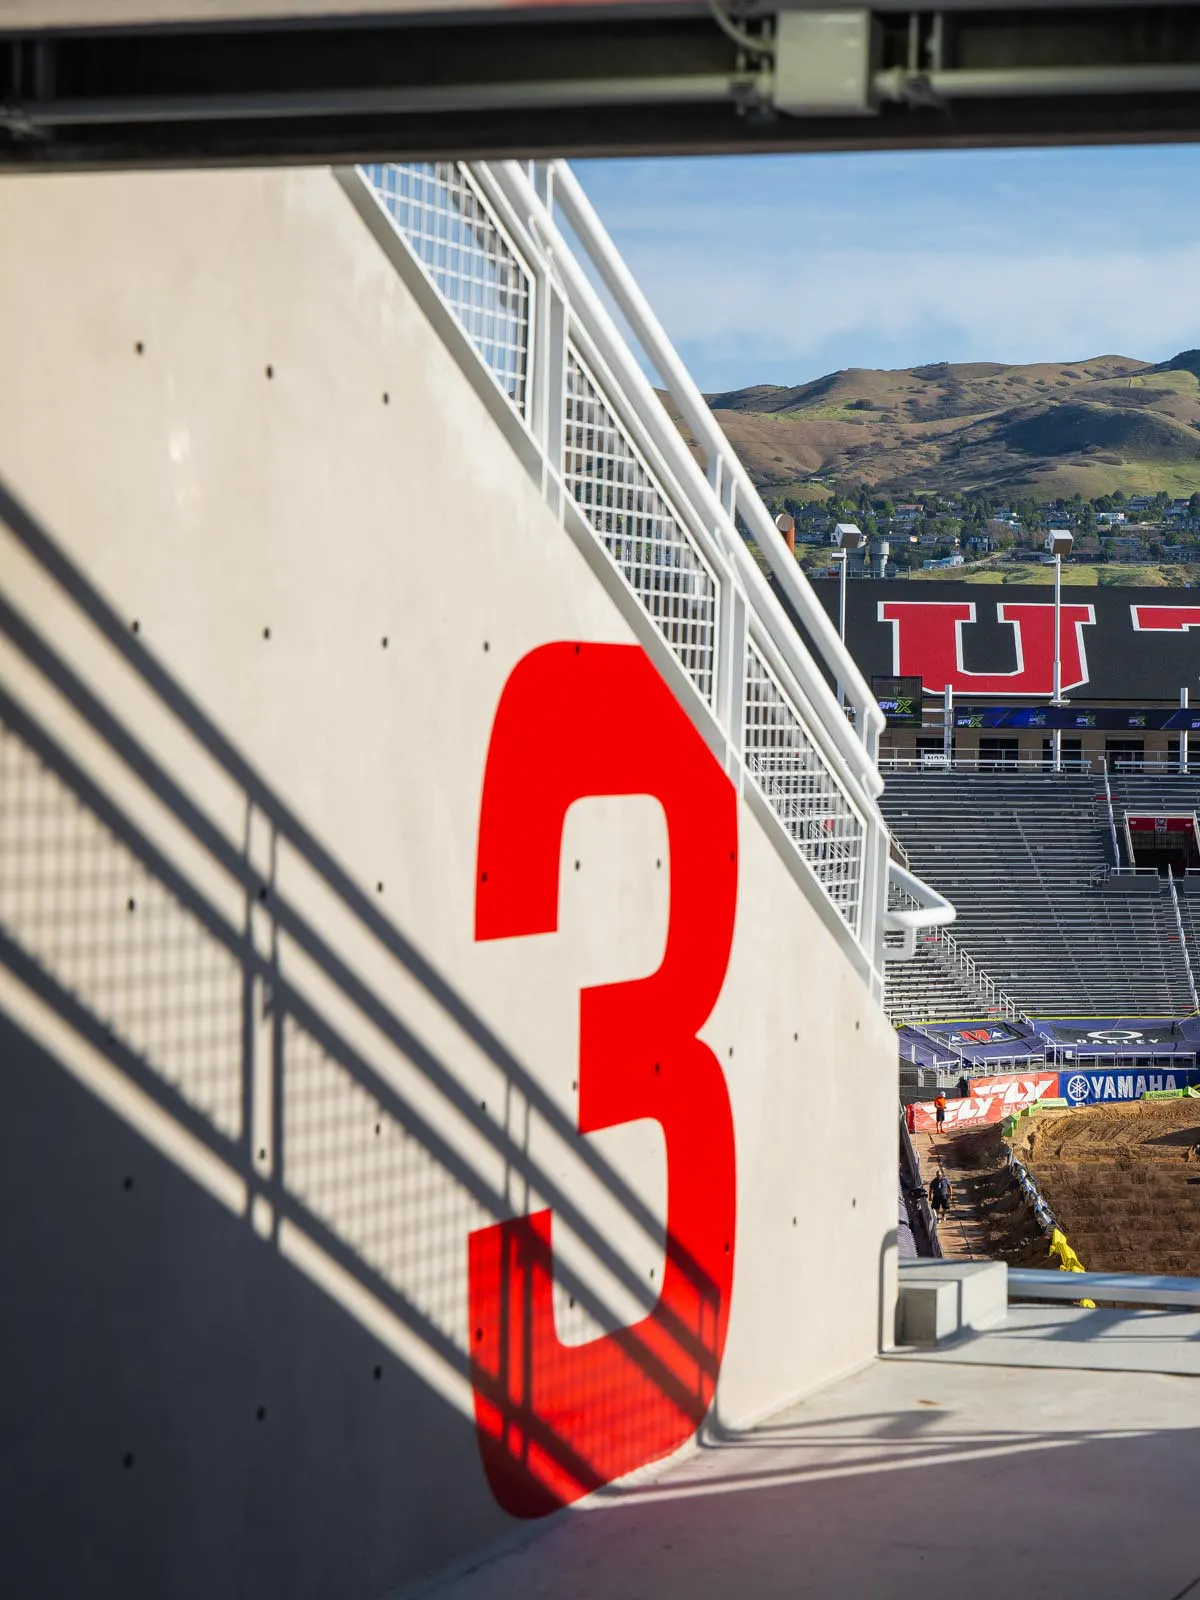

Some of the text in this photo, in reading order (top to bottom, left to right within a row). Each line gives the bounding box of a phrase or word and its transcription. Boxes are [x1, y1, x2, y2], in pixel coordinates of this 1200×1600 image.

[878, 699, 913, 713] SMX
[957, 716, 984, 728] SMX
[468, 640, 738, 1519] 3
[972, 1079, 1055, 1104] FLY
[1090, 1074, 1177, 1099] YAMAHA
